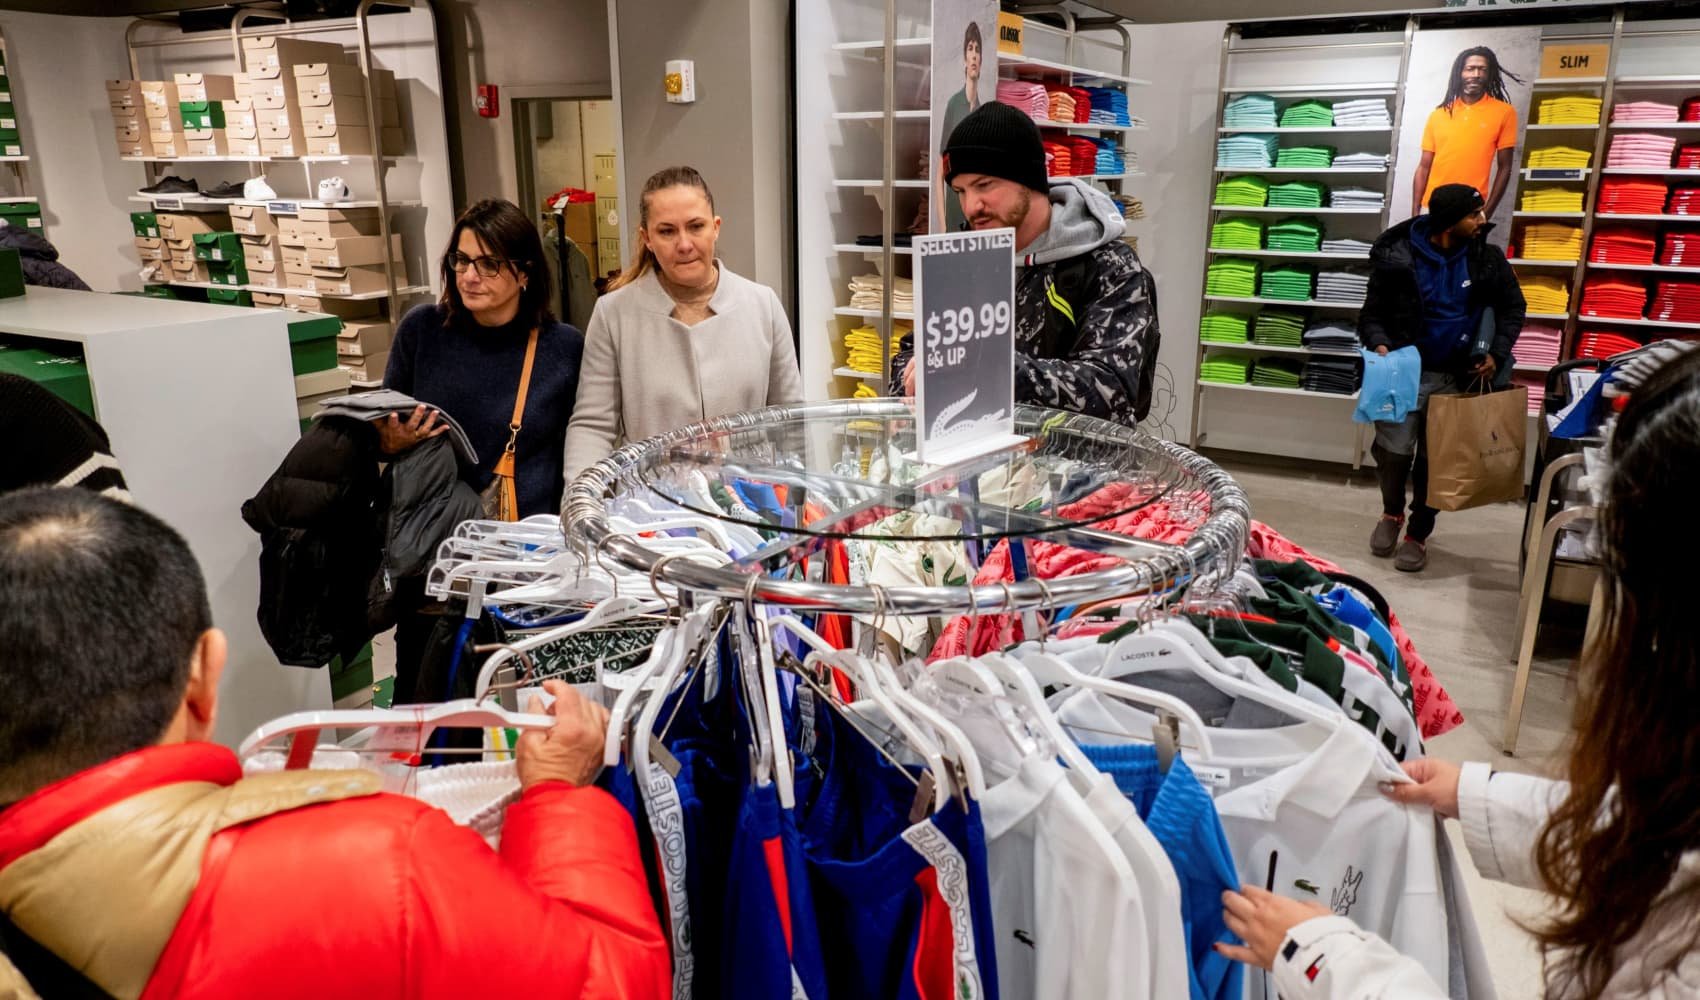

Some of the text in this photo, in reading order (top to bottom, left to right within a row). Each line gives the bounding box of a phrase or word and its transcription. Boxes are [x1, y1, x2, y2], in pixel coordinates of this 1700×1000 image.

[1560, 55, 1590, 69] SLIM
[920, 234, 1012, 256] SELECT STYLES
[926, 300, 1011, 352] $39.99
[947, 346, 966, 366] UP
[1120, 650, 1155, 661] LACOSTE
